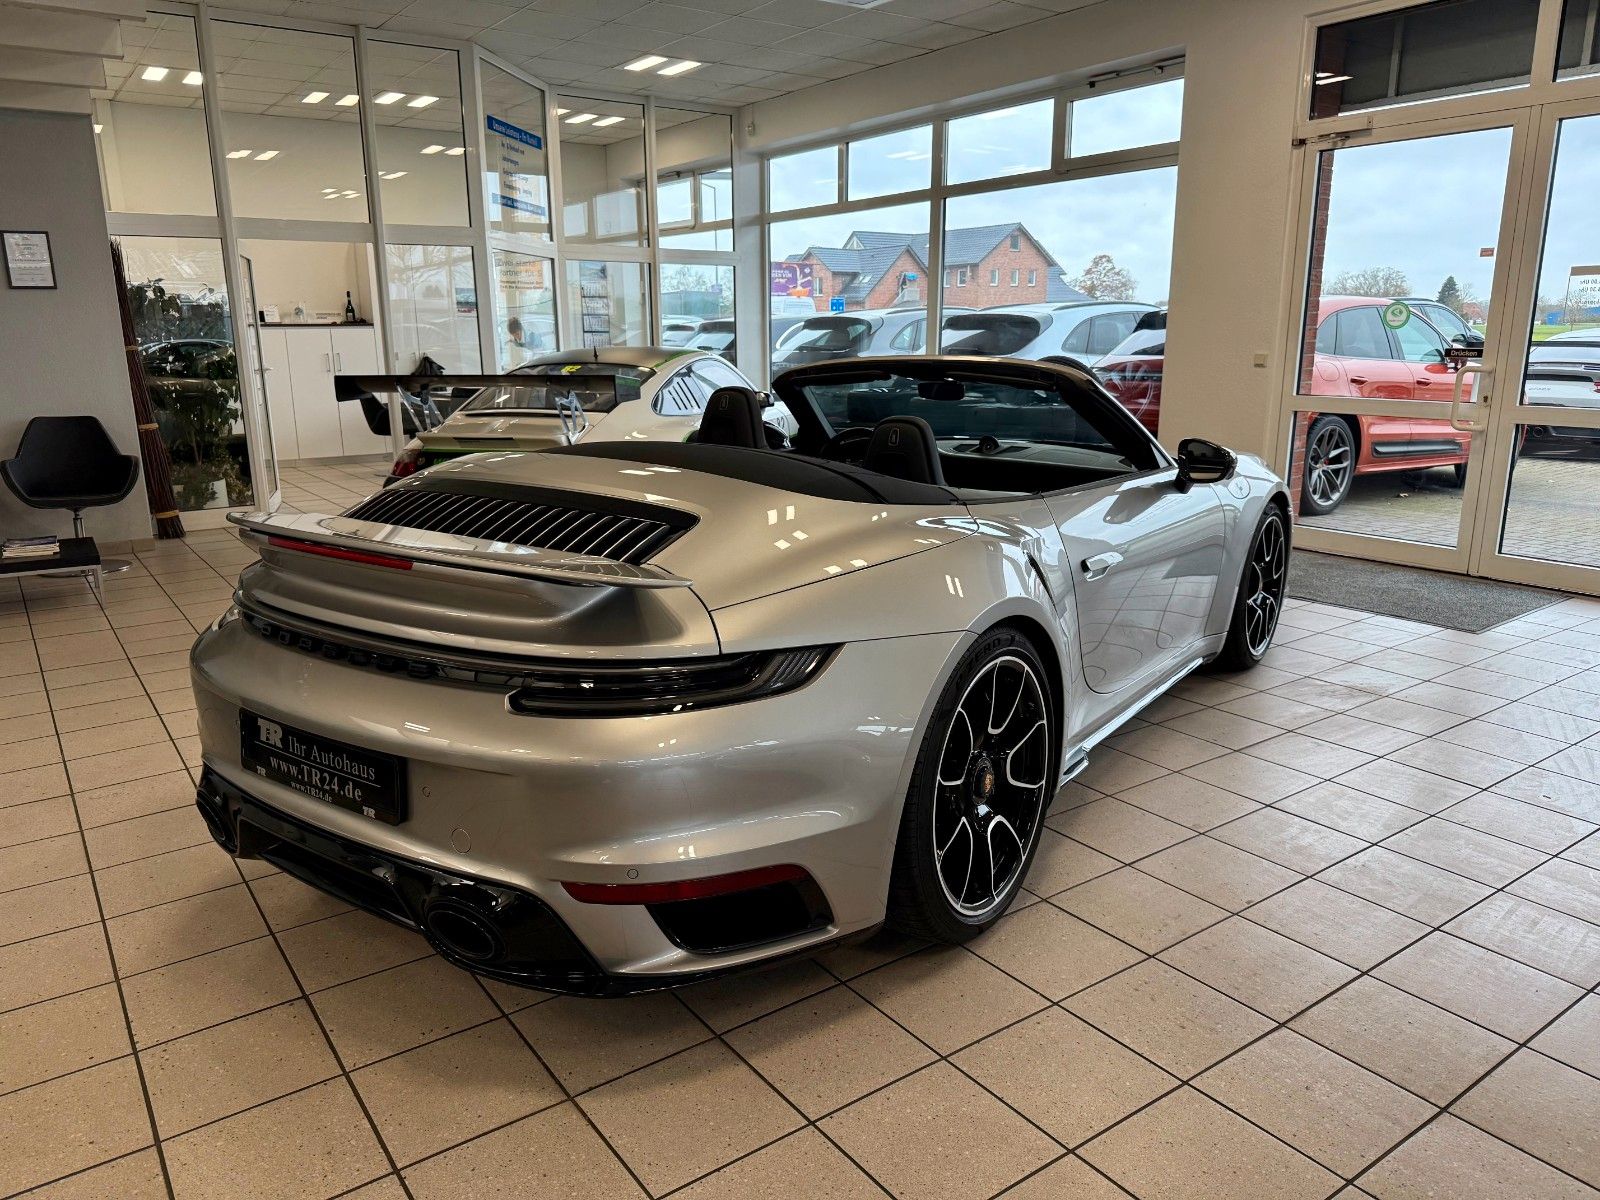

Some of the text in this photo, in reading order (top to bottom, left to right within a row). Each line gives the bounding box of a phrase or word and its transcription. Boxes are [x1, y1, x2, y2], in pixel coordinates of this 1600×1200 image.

[1450, 349, 1478, 357] Drücken
[257, 717, 284, 749] TR
[288, 735, 376, 781] Ihr Autohaus
[256, 765, 267, 777] TR
[269, 756, 363, 802] www.TR24.de
[290, 781, 334, 804] www.TR24.de
[362, 805, 376, 819] TR
